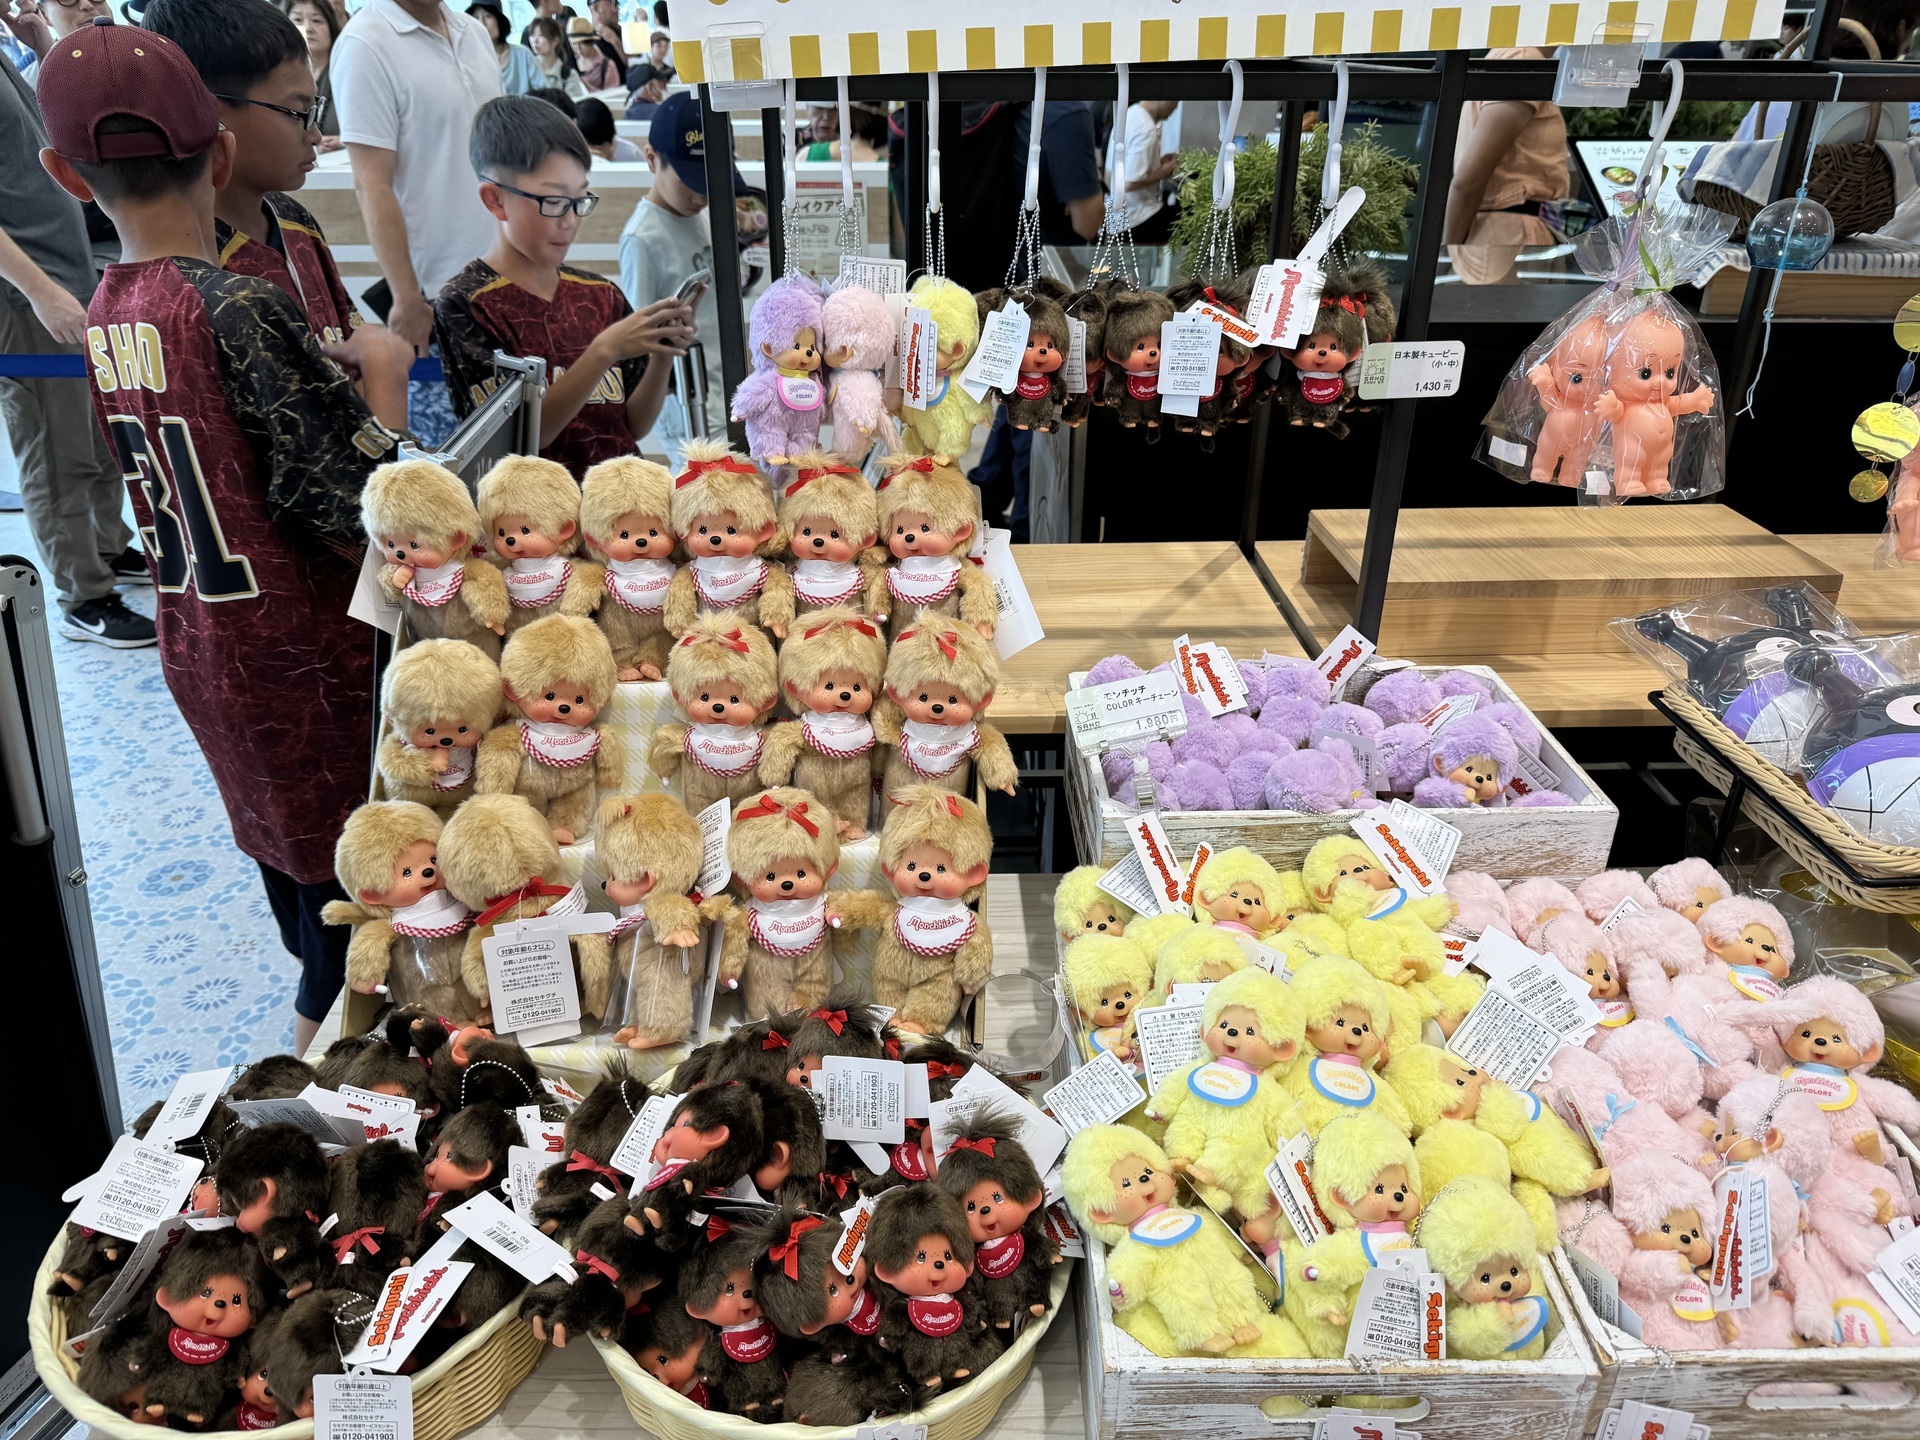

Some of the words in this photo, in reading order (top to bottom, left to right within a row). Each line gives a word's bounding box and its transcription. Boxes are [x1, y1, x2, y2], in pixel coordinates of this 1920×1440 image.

[1271, 268, 1302, 340] Monchhichi
[87, 322, 167, 393] SHO
[906, 322, 920, 394] Sekiguchi
[1415, 381, 1441, 392] 1,430
[1443, 383, 1451, 391] 円
[107, 415, 260, 602] 31
[1178, 645, 1199, 696] Sekiguchi
[1192, 652, 1232, 708] Monchhichi
[1106, 699, 1134, 711] COLOR
[1135, 690, 1179, 706] キーチェーン
[698, 738, 751, 755] Monchhichi
[1138, 822, 1180, 903] Monchhichi
[1375, 823, 1433, 888] Sekiguchi
[1181, 844, 1211, 907] Sekiguchi
[767, 914, 820, 935] Monchhichi
[906, 914, 960, 932] Monchhichi
[511, 992, 557, 1005] 株式会社セキグチ
[1754, 985, 1777, 998] COLORS
[523, 1008, 562, 1019] 0120-041903
[1205, 1079, 1229, 1092] COLORS
[1334, 1081, 1359, 1092] COLORS
[1803, 1087, 1832, 1097] COLORS
[112, 1195, 160, 1215] 0120-041903
[1294, 1160, 1335, 1235] Sekiguc
[100, 1212, 143, 1232] Sekiguchi
[838, 1207, 871, 1270] Sekiguchi
[1714, 1190, 1738, 1286] Sekiguchi
[1674, 1295, 1703, 1304] COLORS
[368, 1273, 409, 1347] Sekiguchi
[1380, 1314, 1416, 1327] 株式会社セキグチ
[1423, 1292, 1443, 1359] Sekig
[1375, 1333, 1420, 1350] 0120-041903
[338, 1382, 387, 1391] 対象年齢6歳以上
[342, 1432, 394, 1440] 0120-041903
